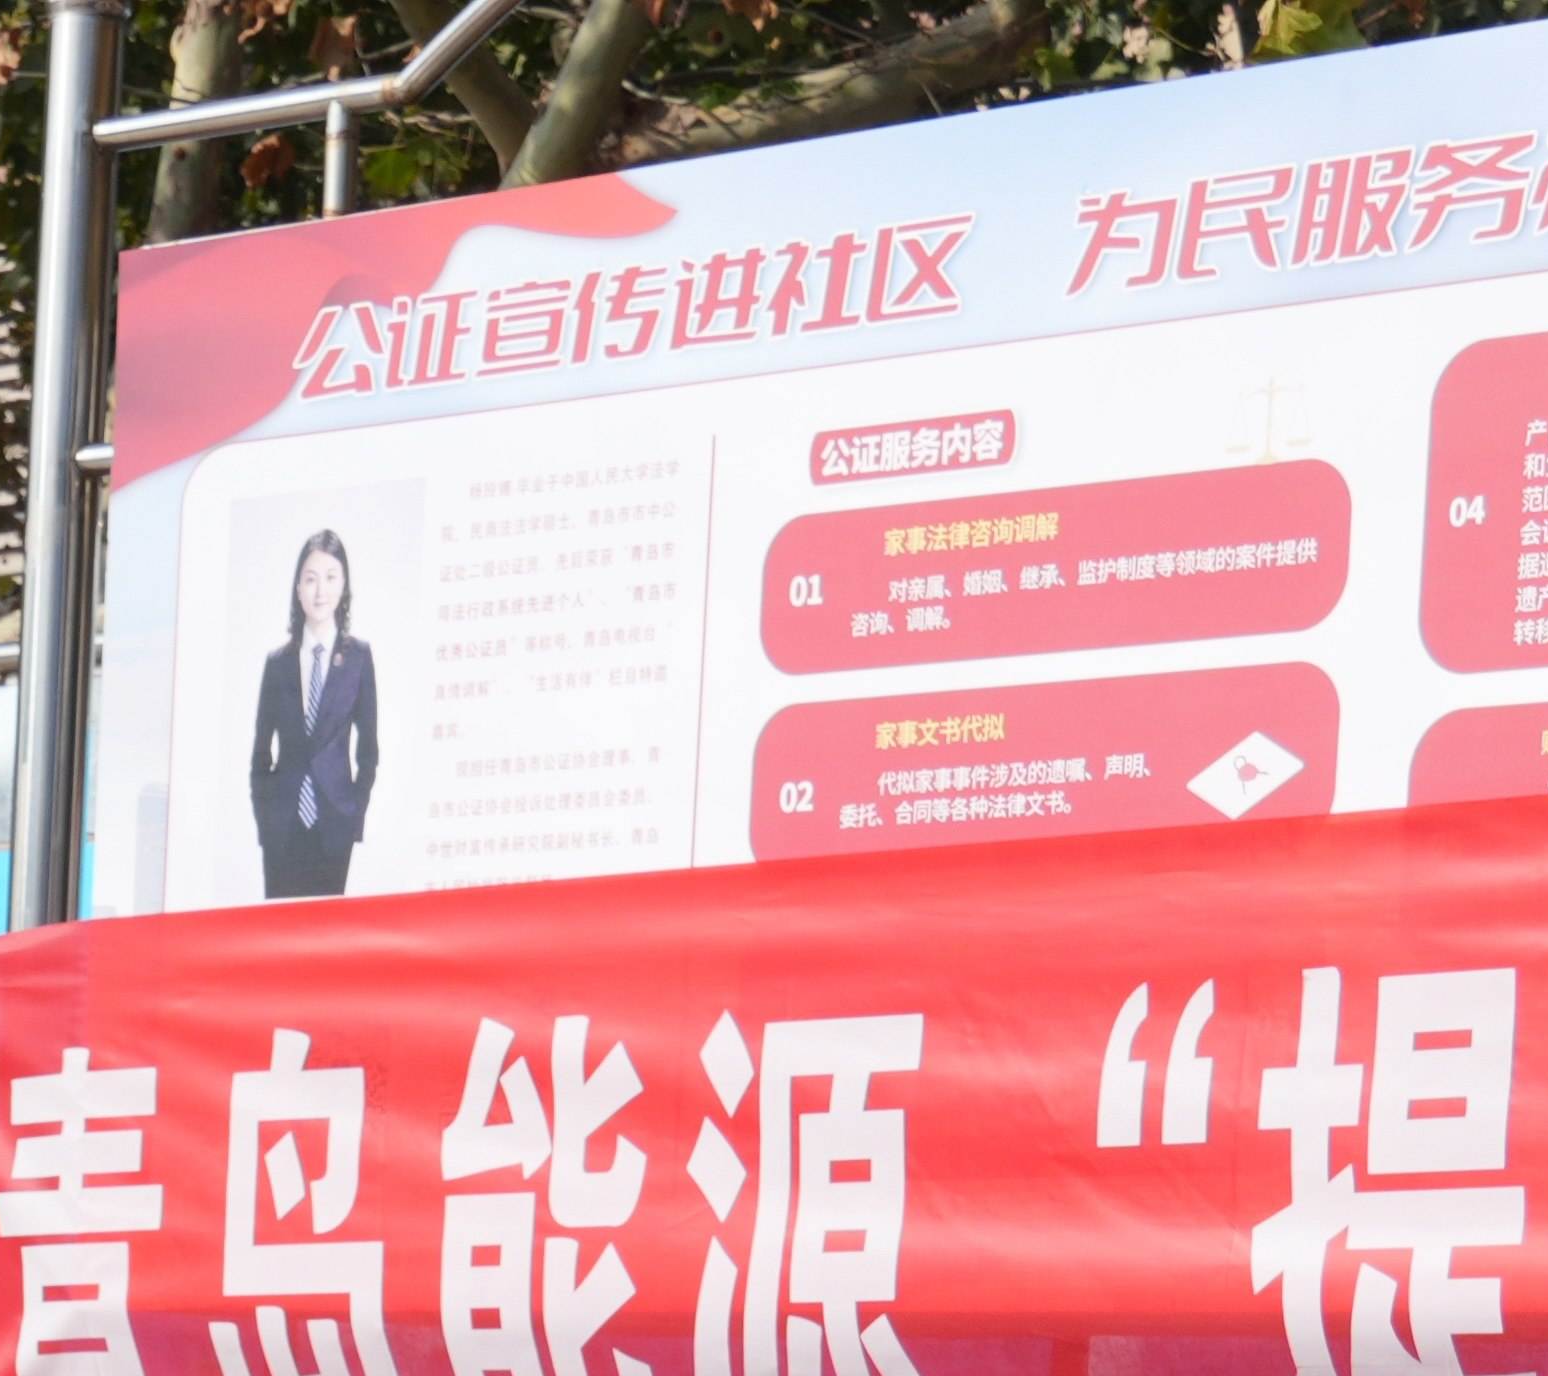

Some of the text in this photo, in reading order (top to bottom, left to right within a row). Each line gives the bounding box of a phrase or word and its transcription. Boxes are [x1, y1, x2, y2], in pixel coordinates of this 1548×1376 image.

[293, 214, 975, 400] 公证宣传进社区
[819, 420, 1005, 478] 公证服务内容
[1449, 496, 1485, 528] 04
[884, 512, 1059, 557] 家事法律咨询调解
[788, 574, 823, 607] 01
[850, 606, 952, 637] 咨询、调解。
[875, 714, 1005, 751] 家事文书代拟
[779, 782, 814, 812] 02
[839, 794, 1074, 830] 委托、合同等各种法律文书。
